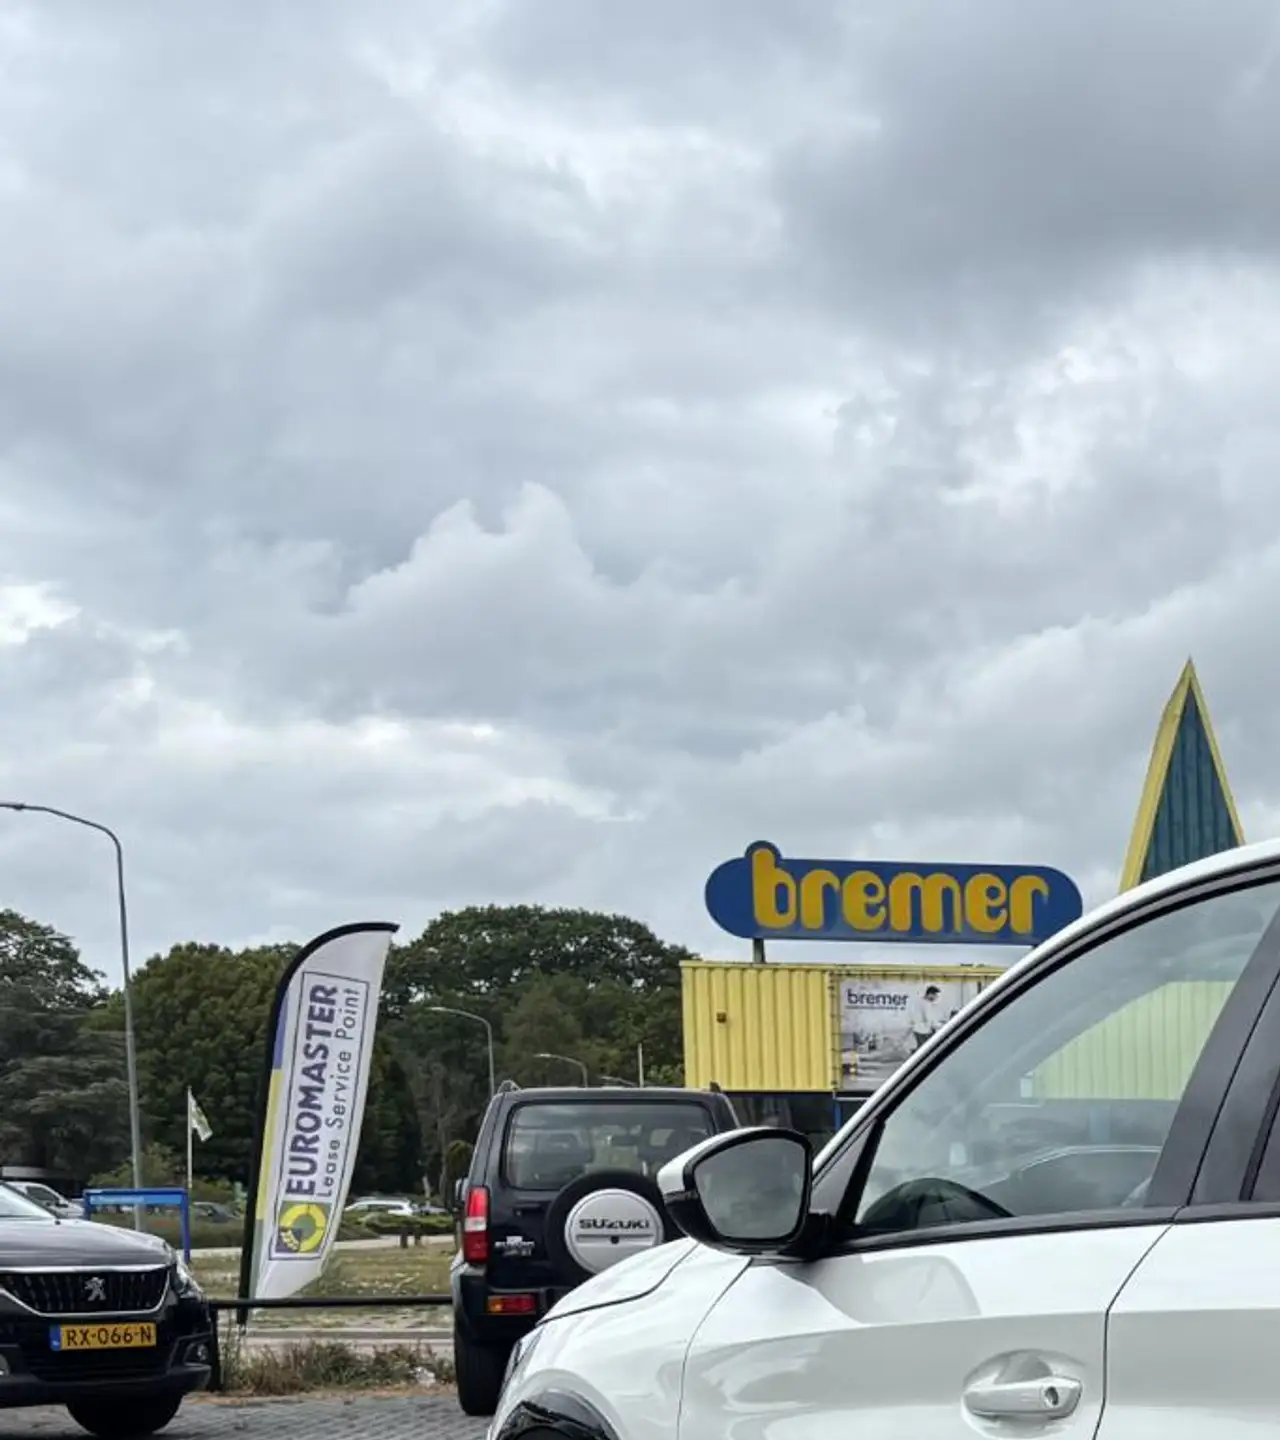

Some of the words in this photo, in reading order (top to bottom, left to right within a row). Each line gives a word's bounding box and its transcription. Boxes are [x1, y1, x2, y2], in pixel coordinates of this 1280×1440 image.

[752, 848, 1049, 933] bremer
[333, 987, 361, 1040] Point
[847, 988, 909, 1005] bremer
[285, 984, 338, 1197] EUROMASTER
[325, 1050, 353, 1130] Service
[316, 1139, 341, 1198] Lease
[579, 1217, 651, 1230] SUZUKI
[65, 1325, 153, 1347] RX-066-N
